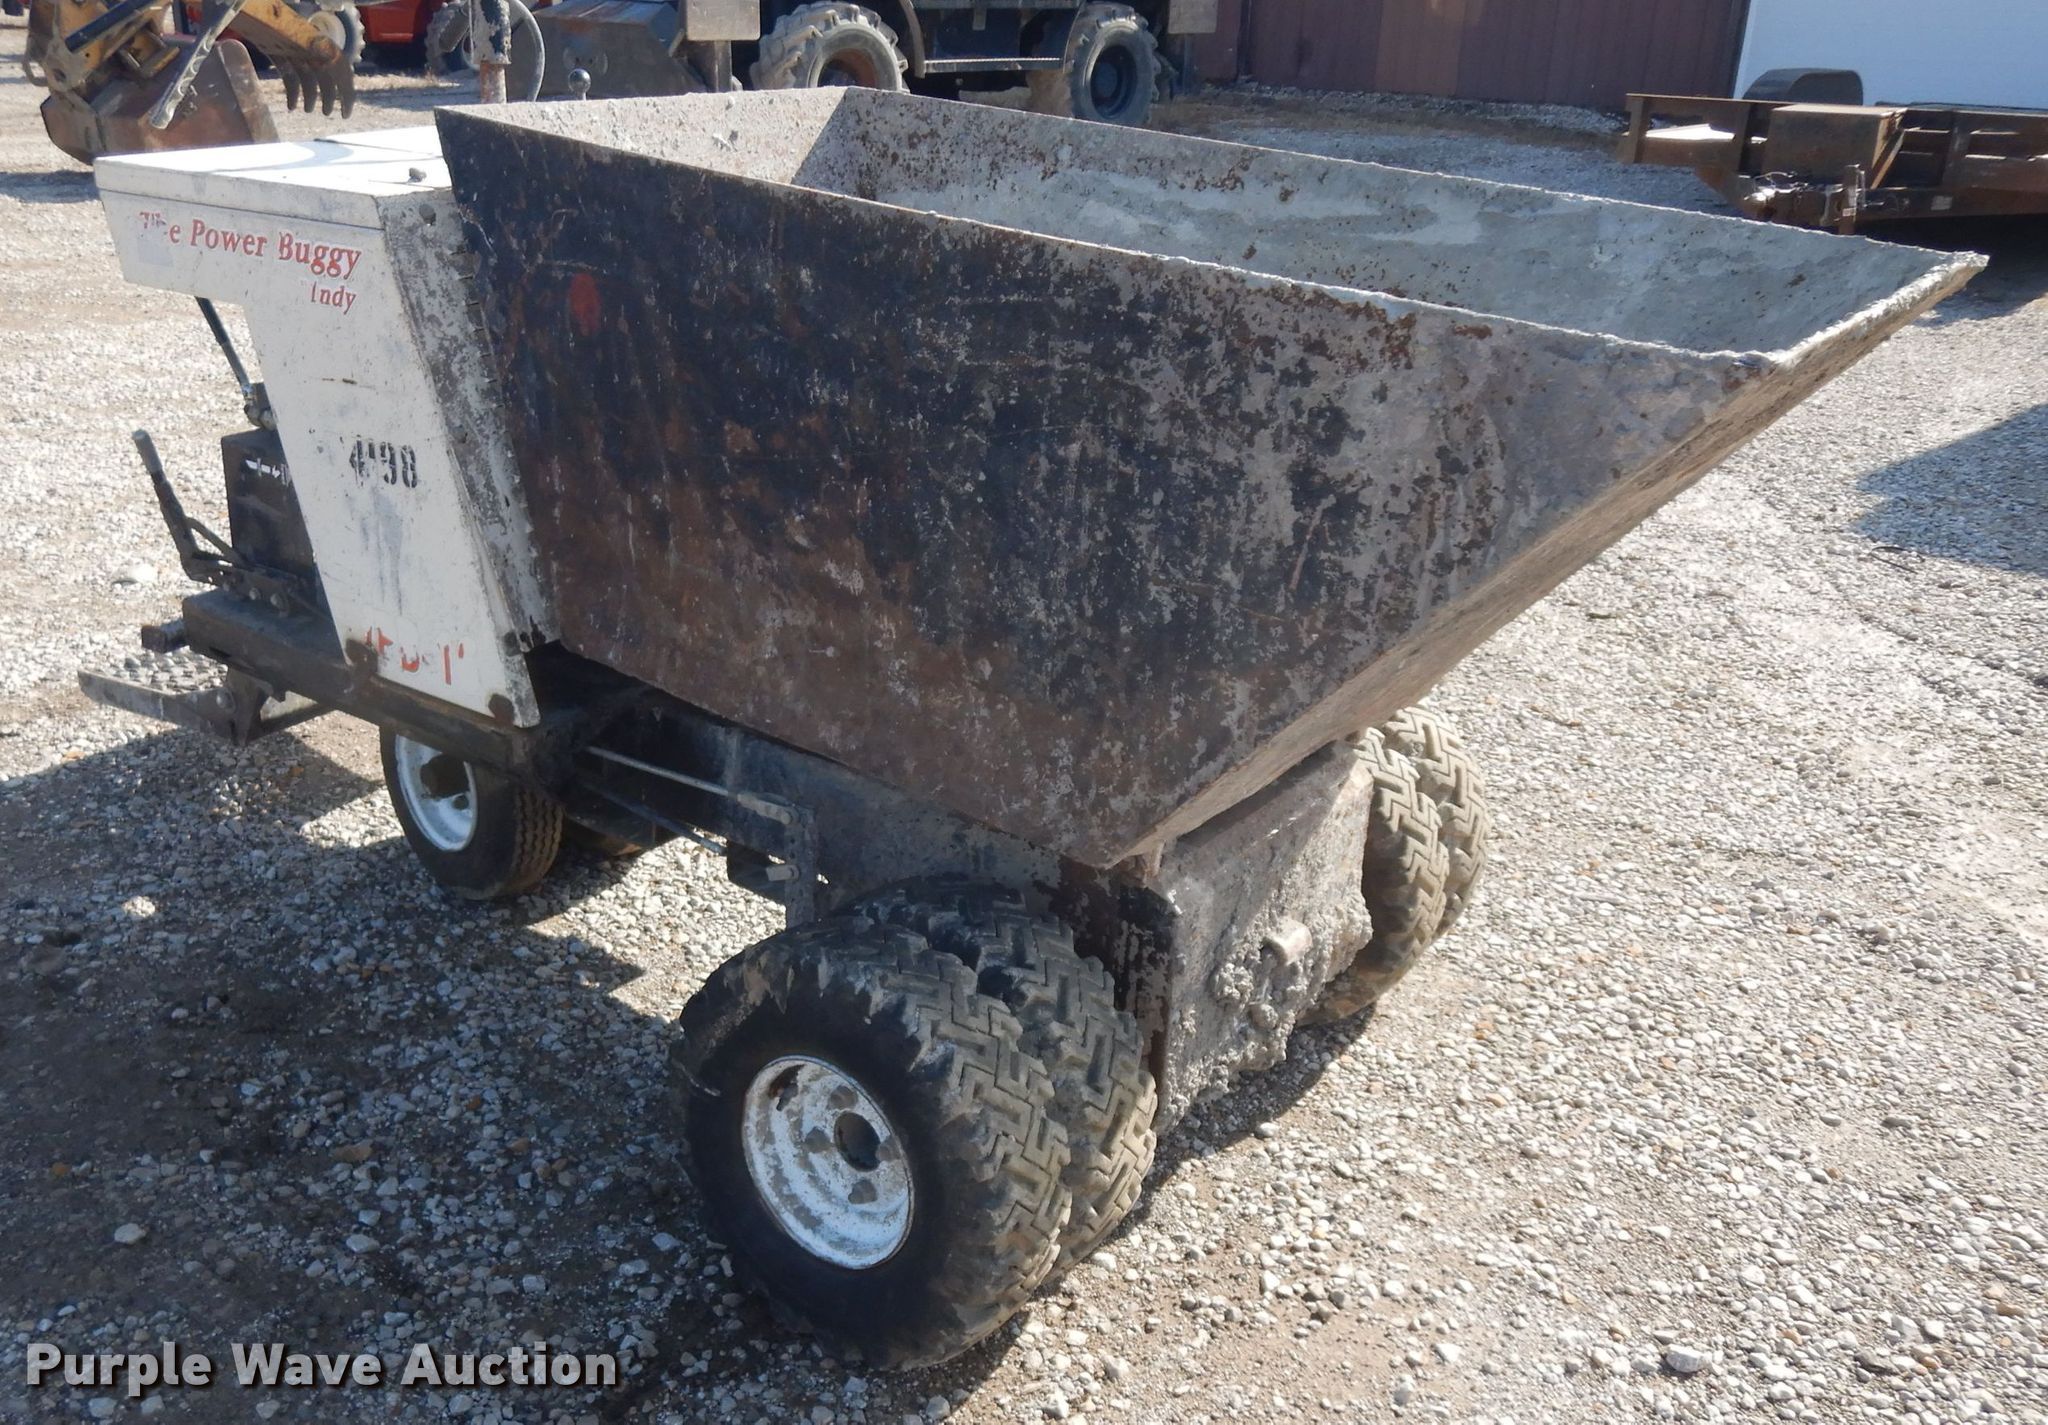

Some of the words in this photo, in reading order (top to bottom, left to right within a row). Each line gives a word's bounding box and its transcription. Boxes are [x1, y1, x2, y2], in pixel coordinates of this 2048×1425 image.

[190, 218, 267, 257] Power
[278, 231, 362, 280] Buggy
[310, 281, 357, 315] Indy
